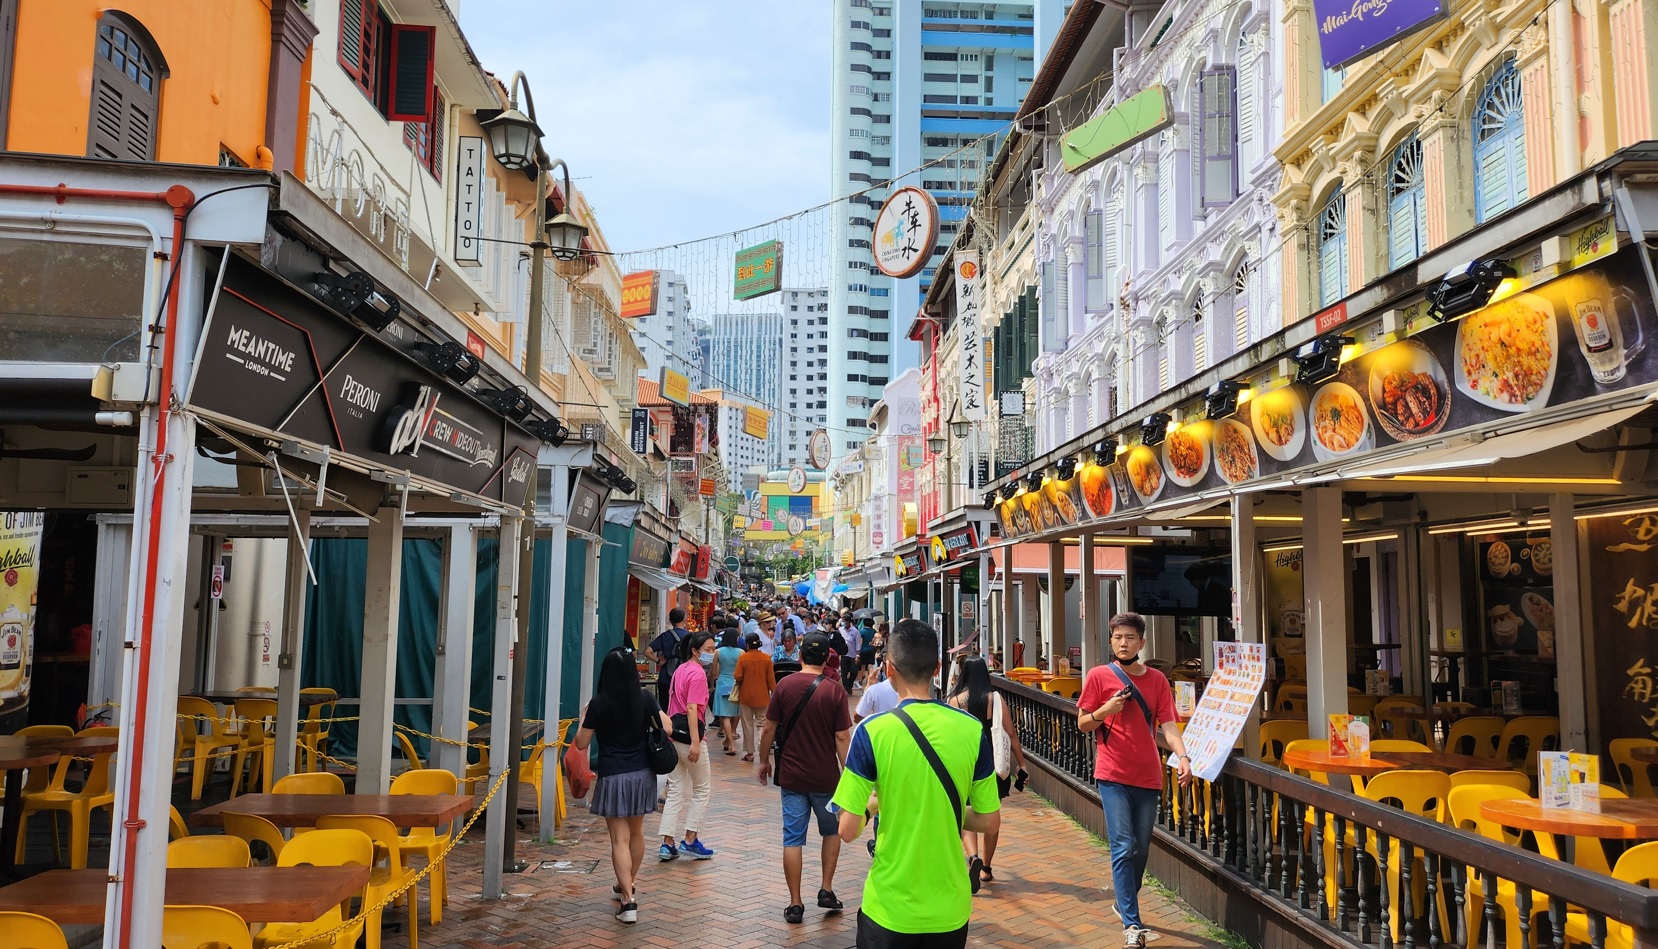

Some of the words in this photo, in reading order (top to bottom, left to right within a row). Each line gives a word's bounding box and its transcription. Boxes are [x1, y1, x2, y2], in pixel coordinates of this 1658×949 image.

[463, 148, 475, 249] TATTOO
[901, 195, 921, 261] 牛车水
[1576, 217, 1610, 256] Highball
[1320, 309, 1342, 329] TSSF-02
[227, 324, 296, 373] MEANTIME
[245, 359, 270, 377] LONDON
[340, 374, 382, 413] PERONI
[347, 407, 364, 420] ITALIA
[428, 418, 454, 444] CREW
[450, 428, 482, 456] HIDEOUT
[5, 512, 18, 530] OF
